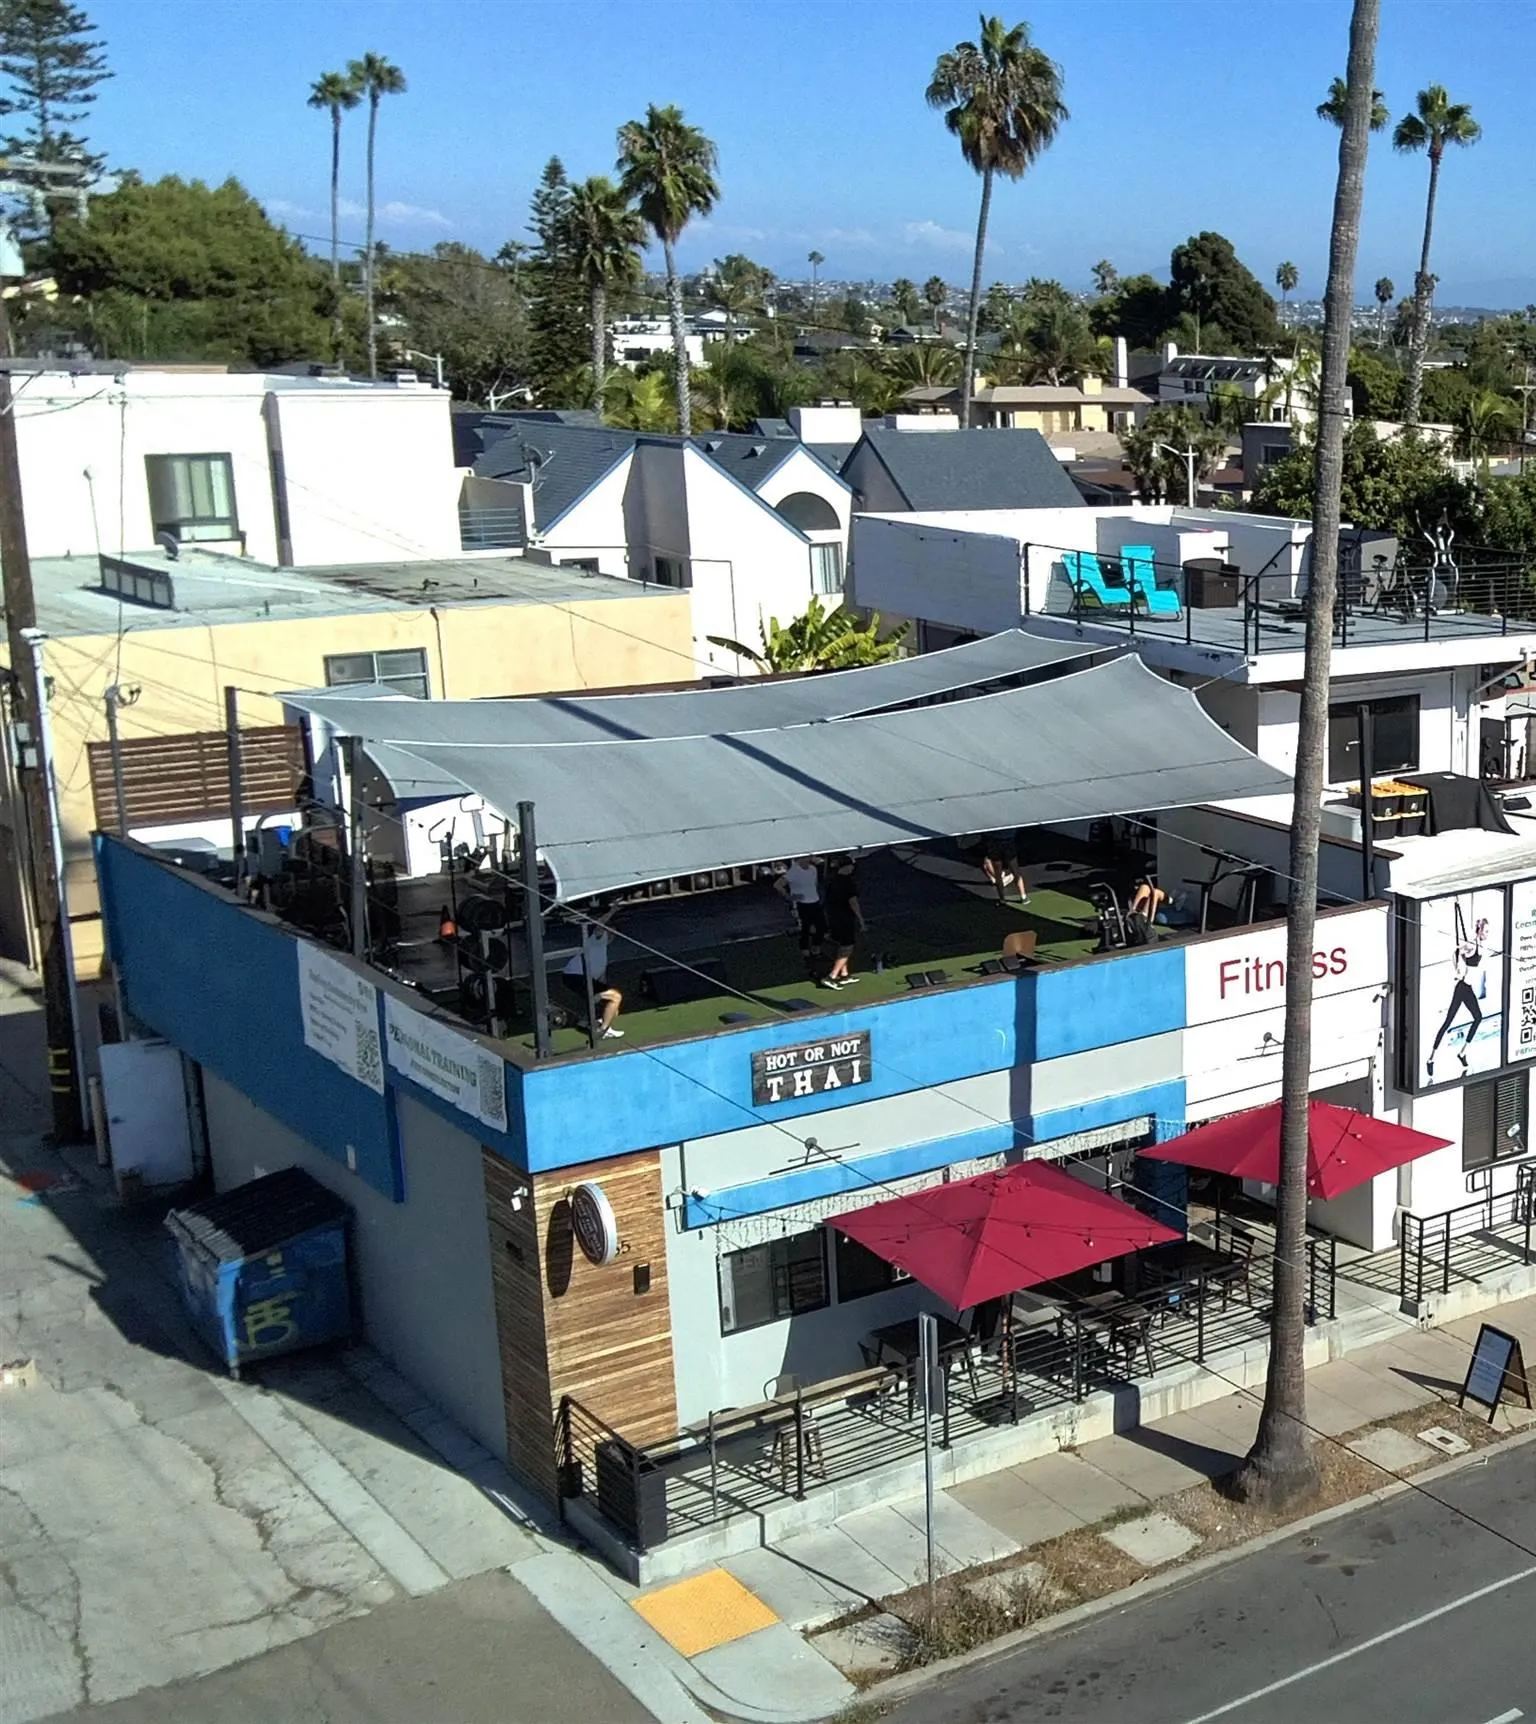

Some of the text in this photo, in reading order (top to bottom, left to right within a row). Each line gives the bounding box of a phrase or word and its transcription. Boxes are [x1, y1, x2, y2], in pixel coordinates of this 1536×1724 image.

[1220, 947, 1348, 1000] Fitnss
[766, 1039, 861, 1071] HOT OR NOT
[766, 1060, 862, 1102] THAI
